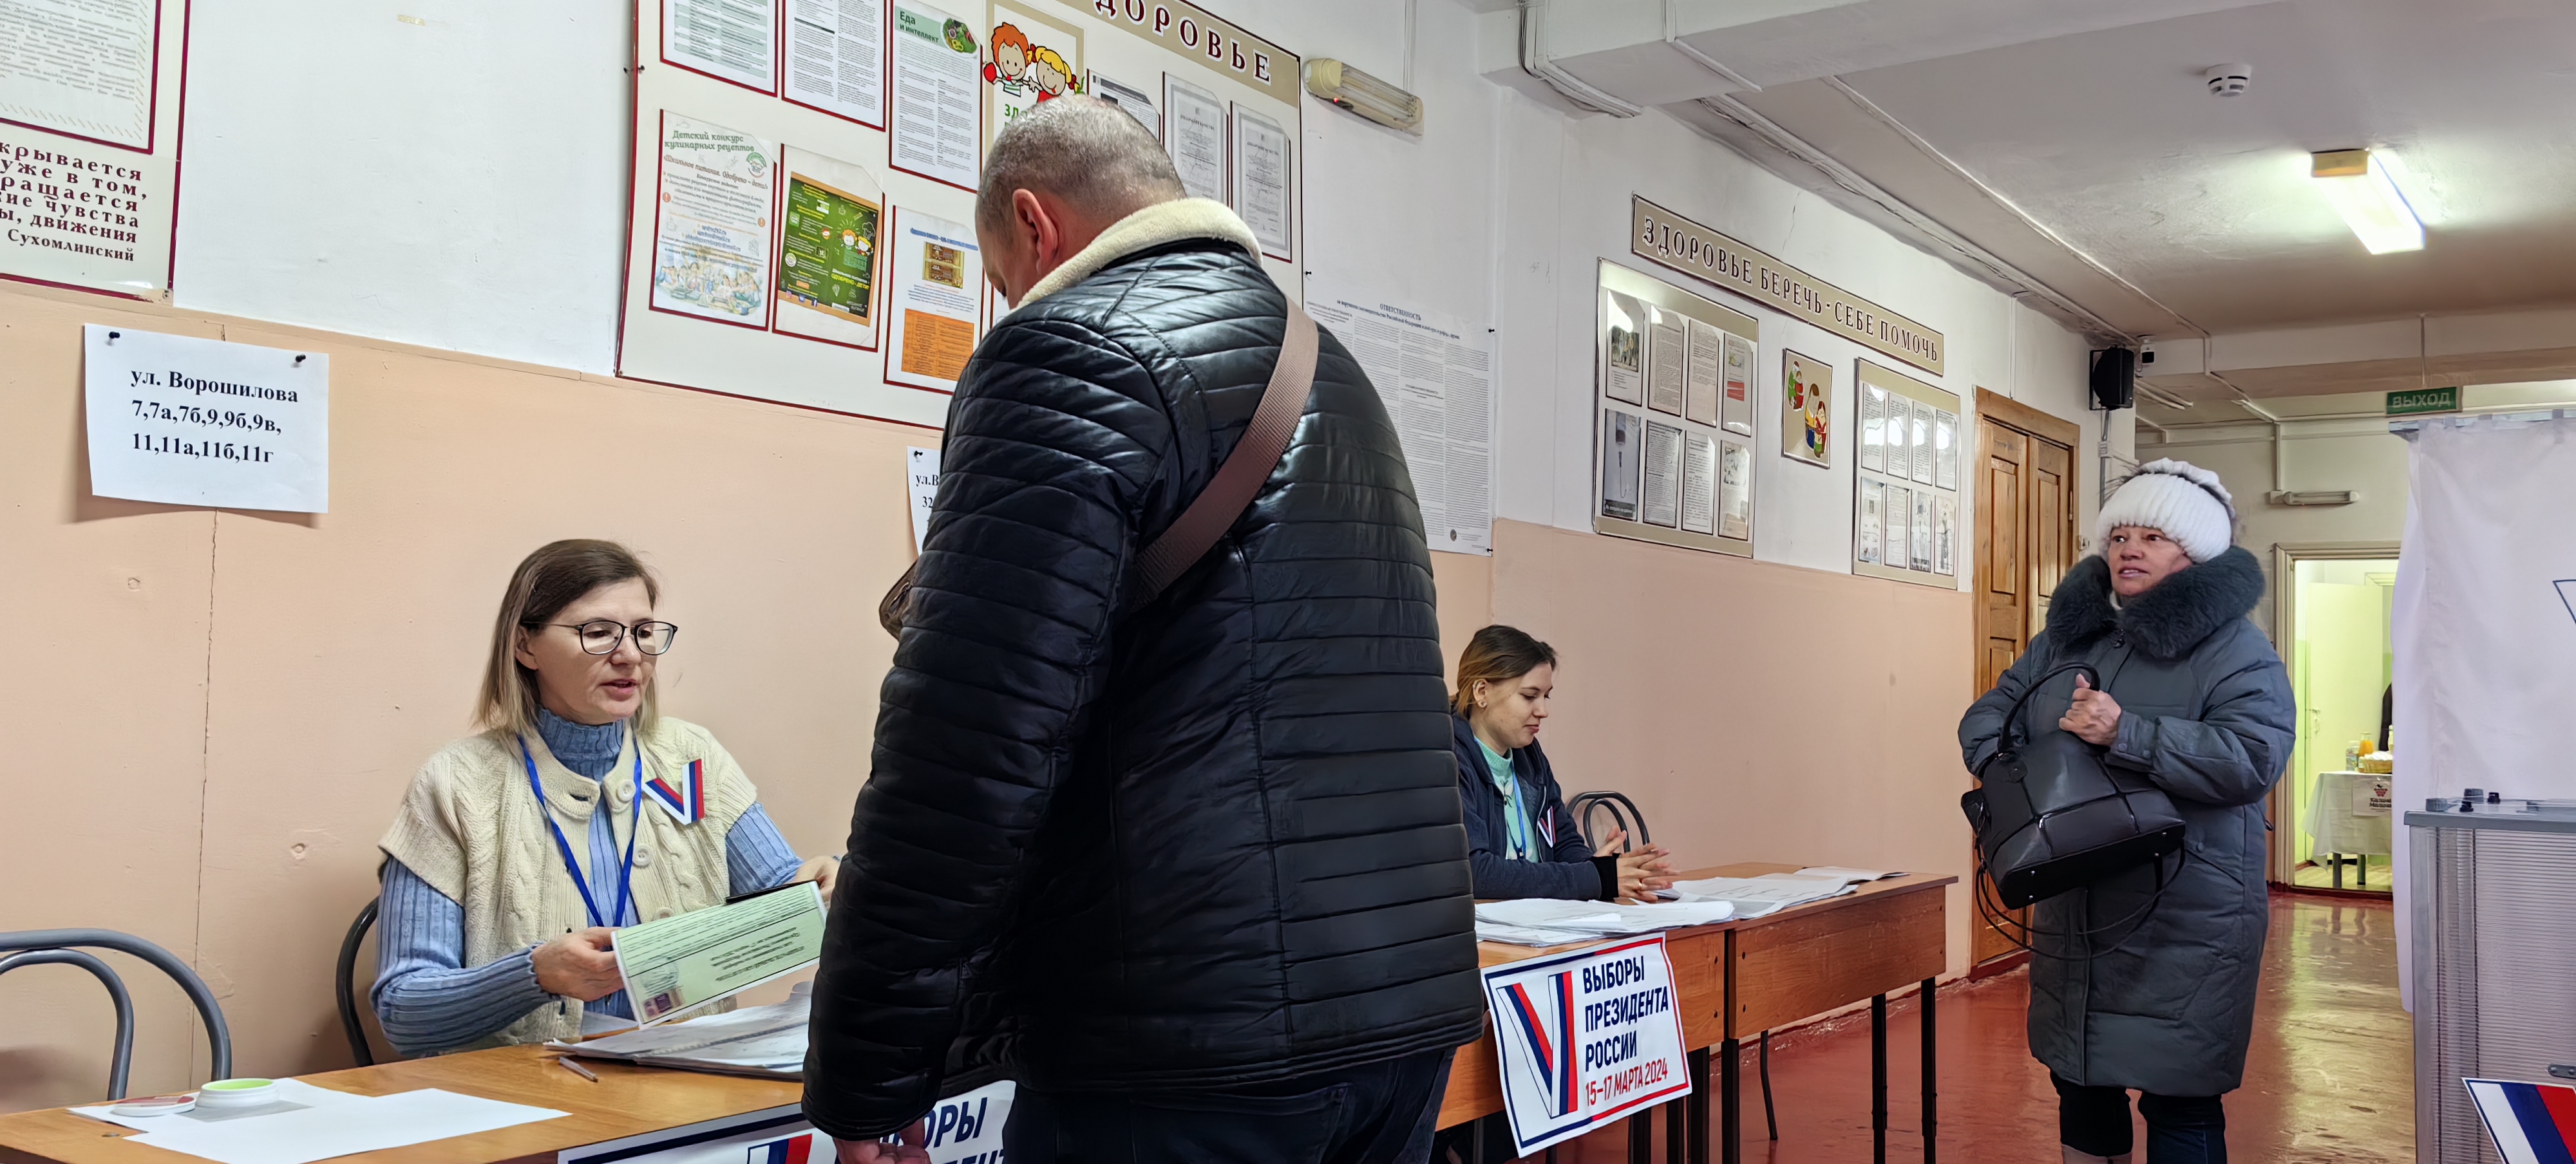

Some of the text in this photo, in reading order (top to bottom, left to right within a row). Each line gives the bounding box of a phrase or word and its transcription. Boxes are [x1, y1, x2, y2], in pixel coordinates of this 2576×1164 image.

[900, 11, 916, 25] Еда
[905, 26, 939, 43] интеллект
[665, 141, 715, 151] кулинарных
[672, 131, 744, 144] Детский конкурс
[0, 159, 147, 200] уже в том,
[1, 176, 138, 212] ращается
[0, 192, 138, 228] ие чувства
[8, 228, 135, 261] Сухомлинский
[30, 214, 137, 243] движения
[1643, 218, 1752, 284] ЗДОРОВЬЕ
[1761, 267, 1822, 314] БЕРЕЧЬ
[1835, 302, 1873, 335] СЕБЕ
[1880, 321, 1937, 362] ПОМОЧЬ
[1379, 303, 1421, 321] ОТВЕТСТВЕННОСТЬ
[131, 370, 298, 402] ул. Ворошилова
[2392, 392, 2452, 408] ВЫХОД
[1582, 955, 1645, 995] ВЫБОРЫ
[1585, 986, 1669, 1033] ПРЕЗИДЕНТА
[1585, 1030, 1638, 1073] РОССИИ
[1614, 1064, 1643, 1097] МАРТА
[1645, 1057, 1668, 1087] 2024
